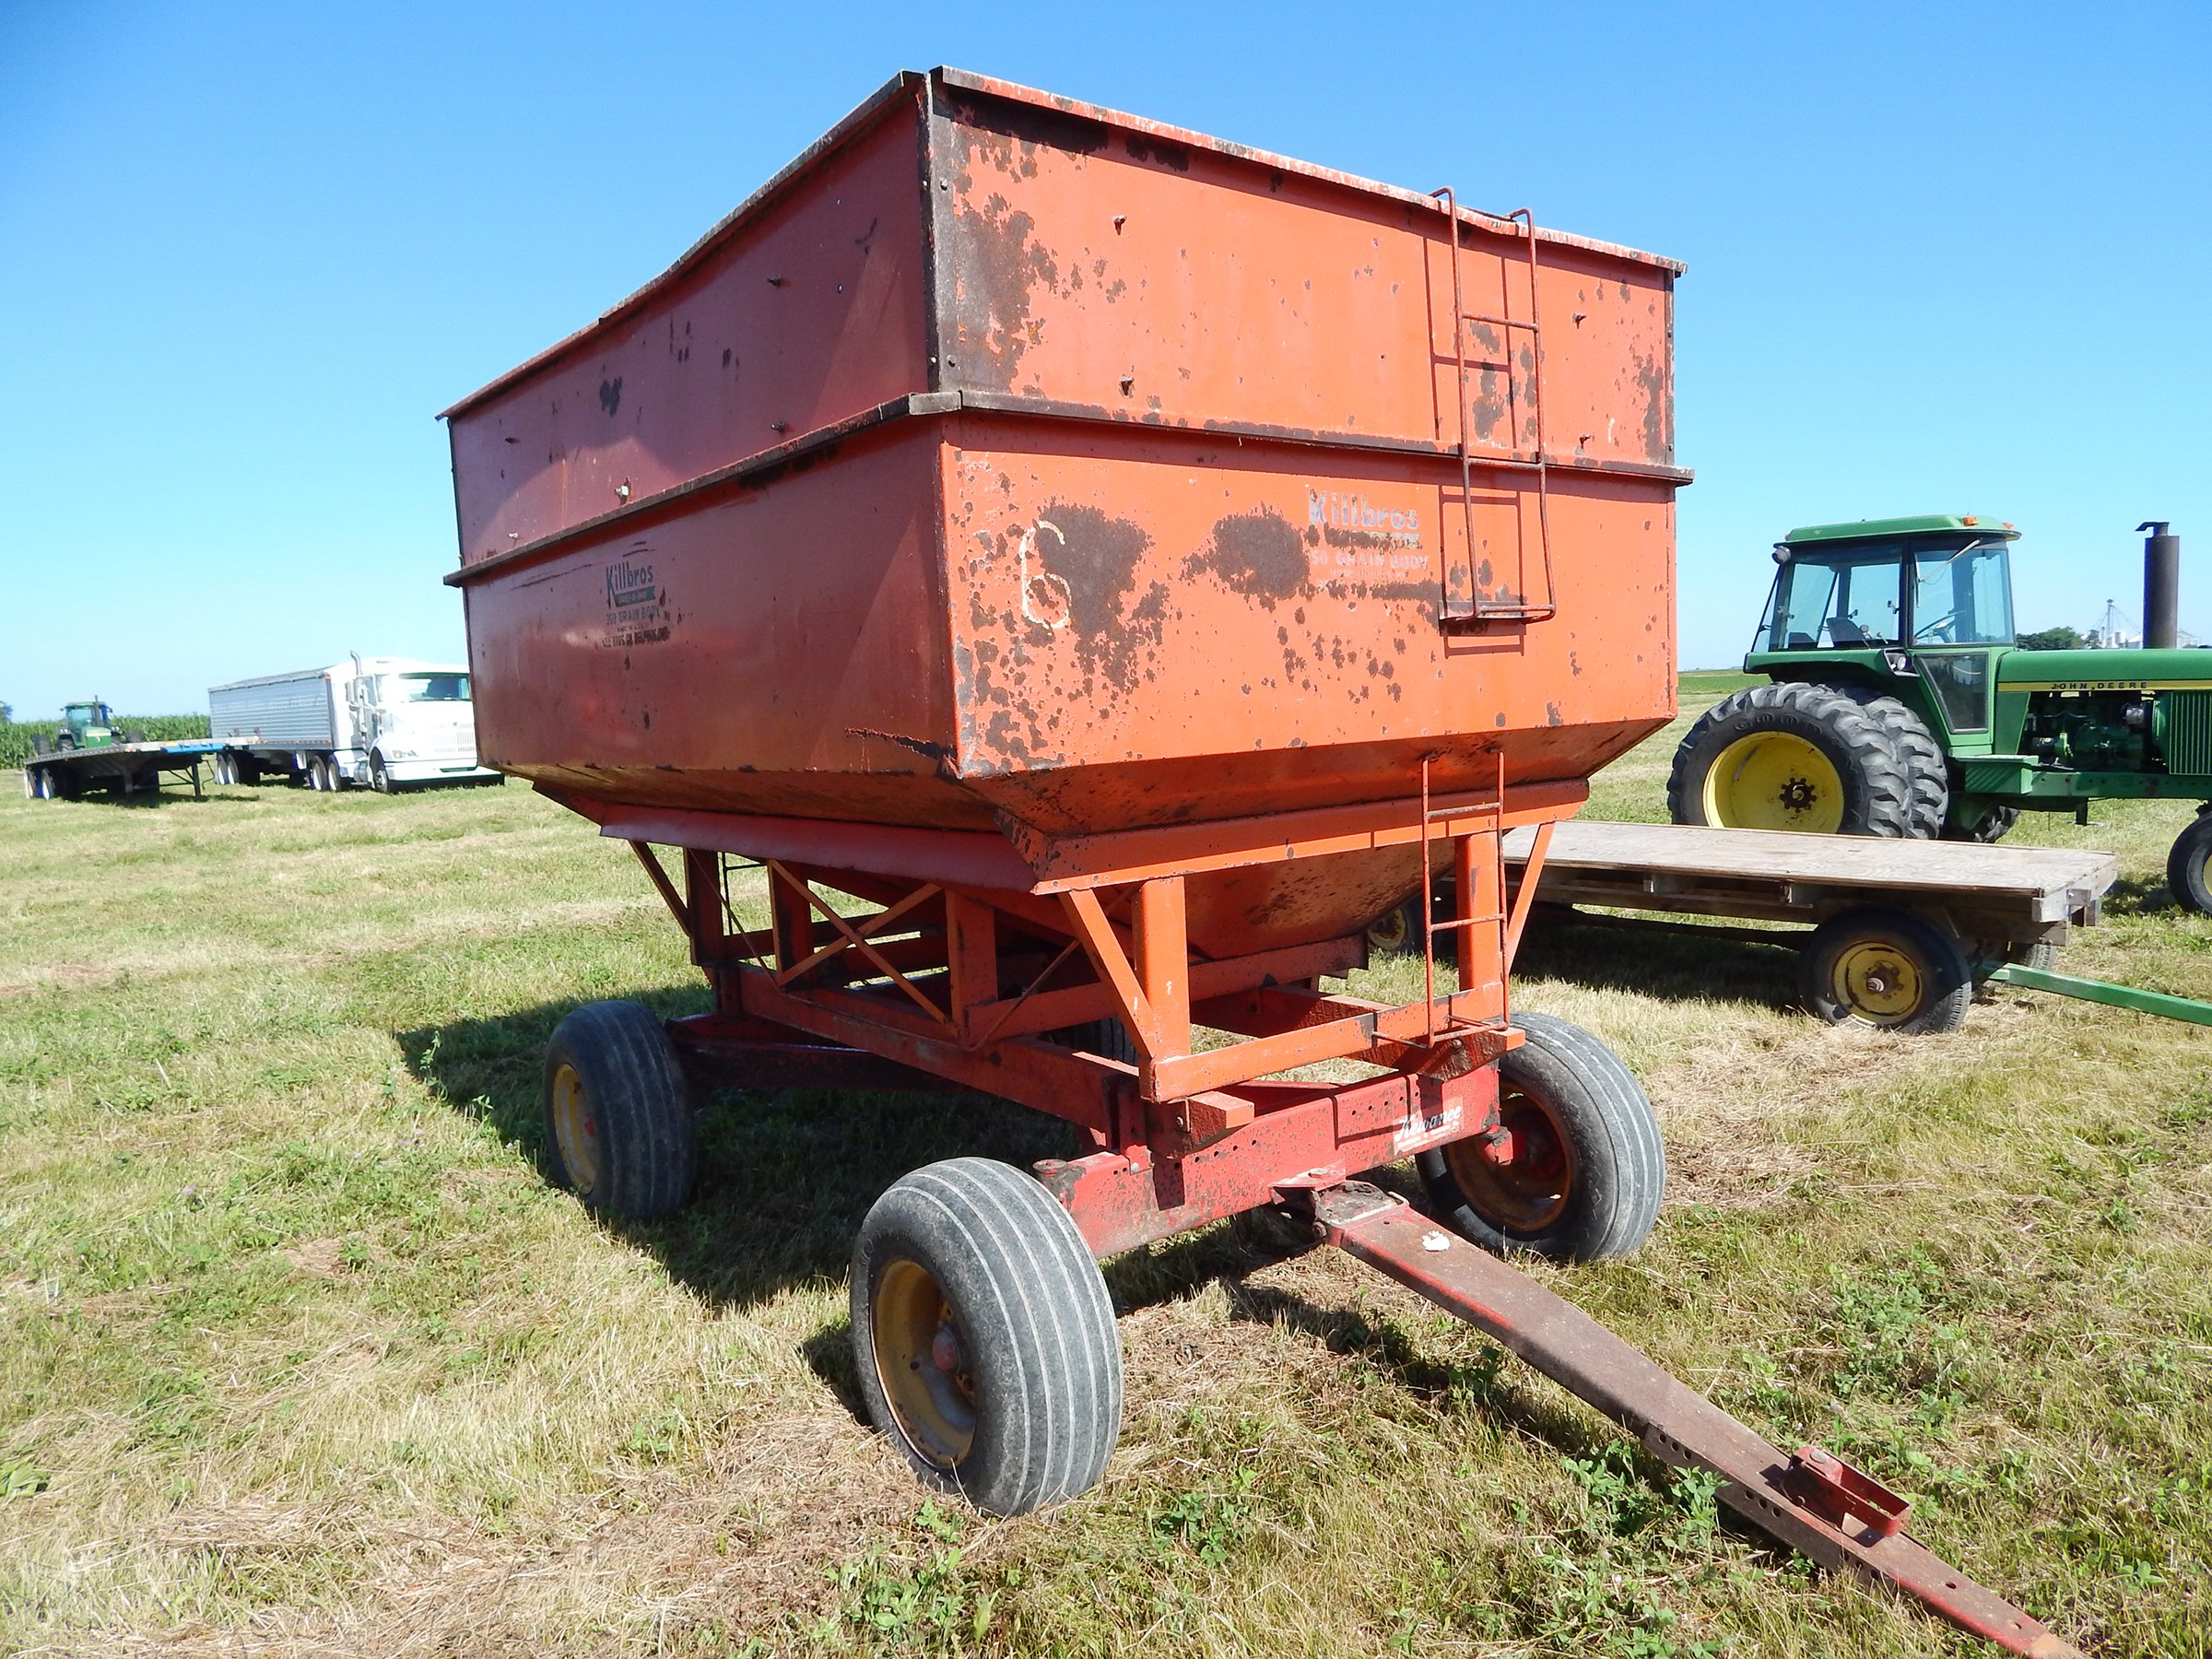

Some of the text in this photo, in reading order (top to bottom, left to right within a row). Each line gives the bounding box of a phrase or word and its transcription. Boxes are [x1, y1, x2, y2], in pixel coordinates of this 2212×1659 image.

[1309, 488, 1419, 531] Killbros
[1018, 520, 1072, 630] 6
[1390, 553, 1430, 570] BODY
[606, 561, 654, 605] Killbros
[618, 607, 640, 624] GRAIN
[641, 604, 661, 620] BODY
[2051, 682, 2088, 690] JOHN
[1394, 1105, 1462, 1143] Kewanee
